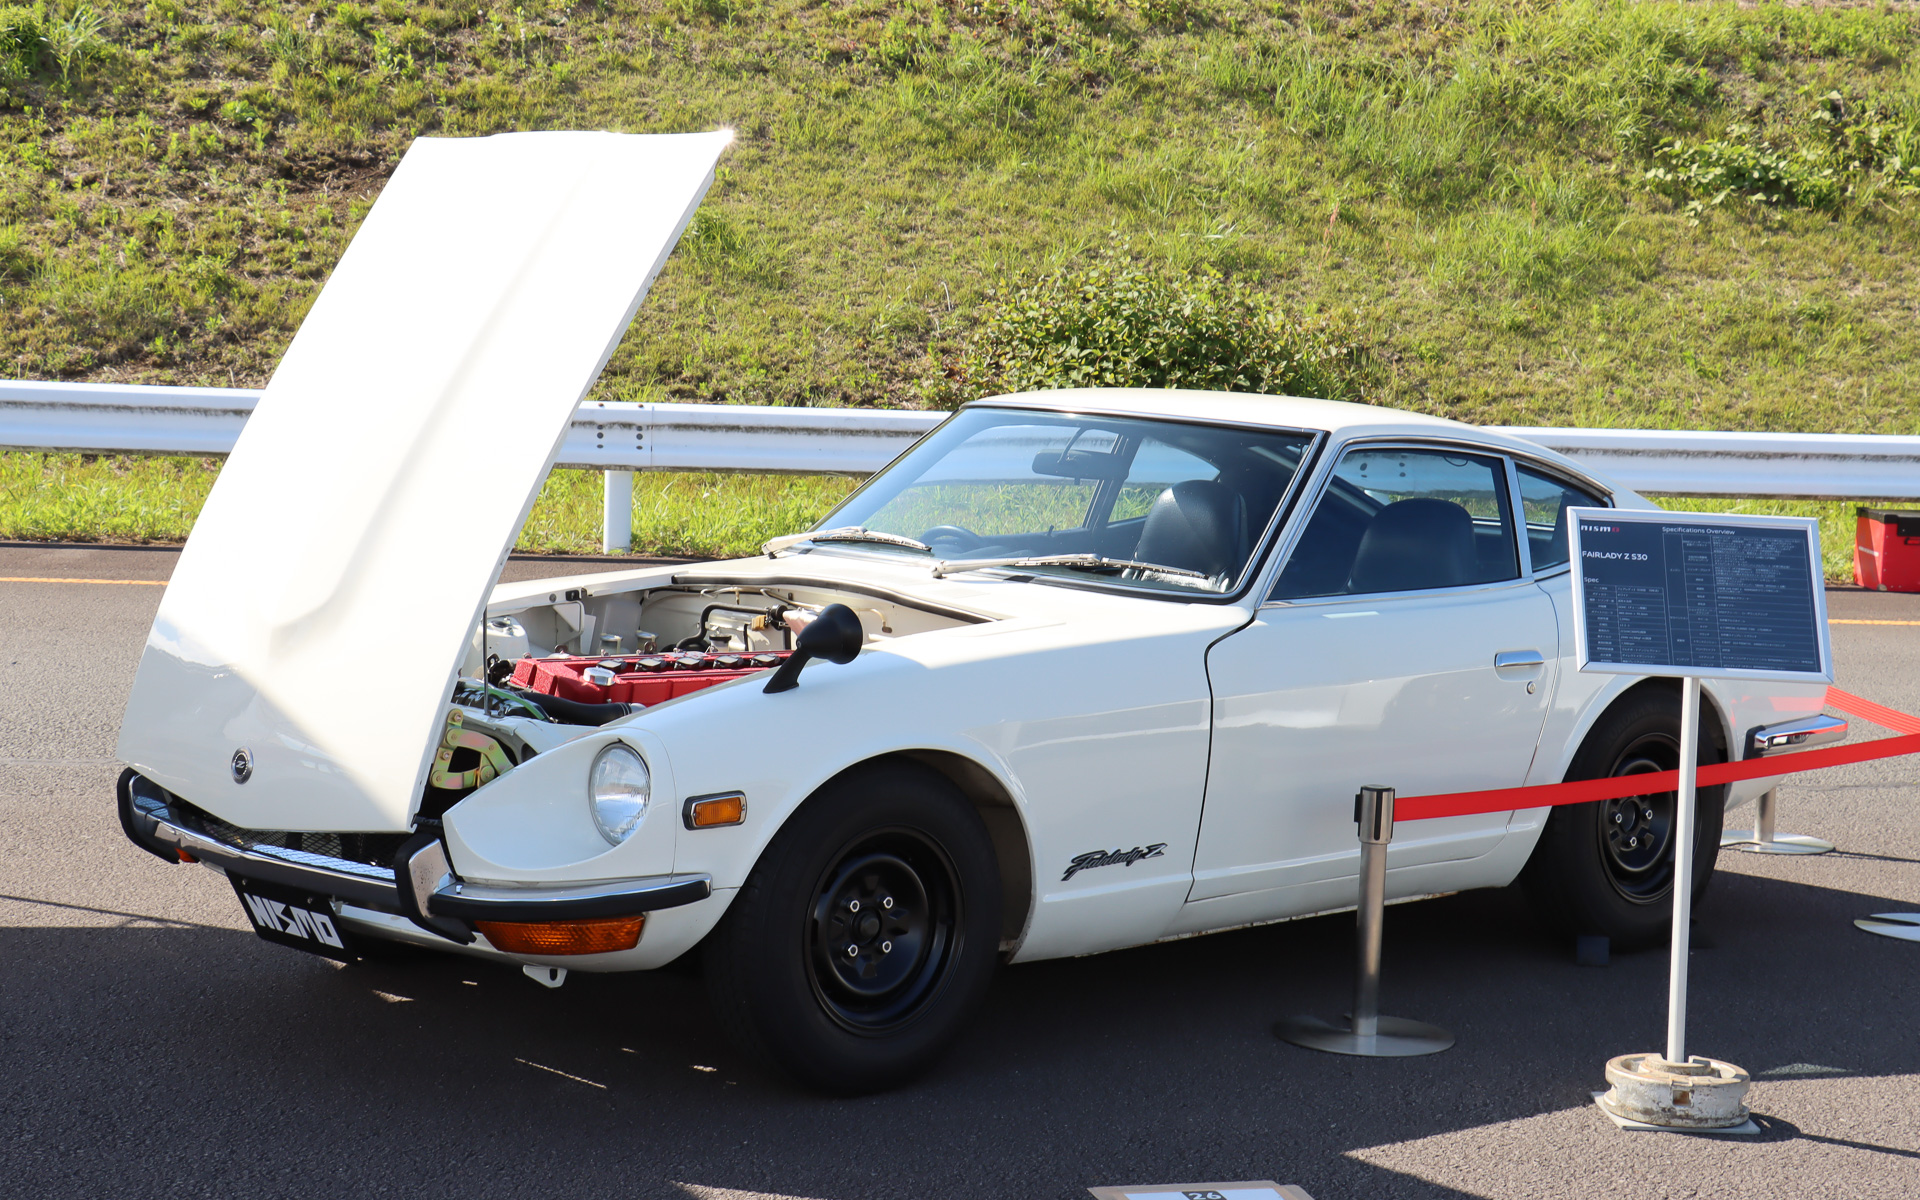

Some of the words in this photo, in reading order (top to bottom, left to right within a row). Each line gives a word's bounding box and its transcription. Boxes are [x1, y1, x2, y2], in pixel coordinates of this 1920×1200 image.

[1581, 525, 1620, 533] nismo
[1662, 526, 1706, 535] Specifications
[1582, 551, 1622, 560] FAIRLADY
[236, 760, 245, 769] Z
[1061, 846, 1143, 881] Fairlady
[1143, 842, 1168, 859] Z
[243, 892, 344, 949] NISMO
[1188, 1192, 1222, 1200] 26
